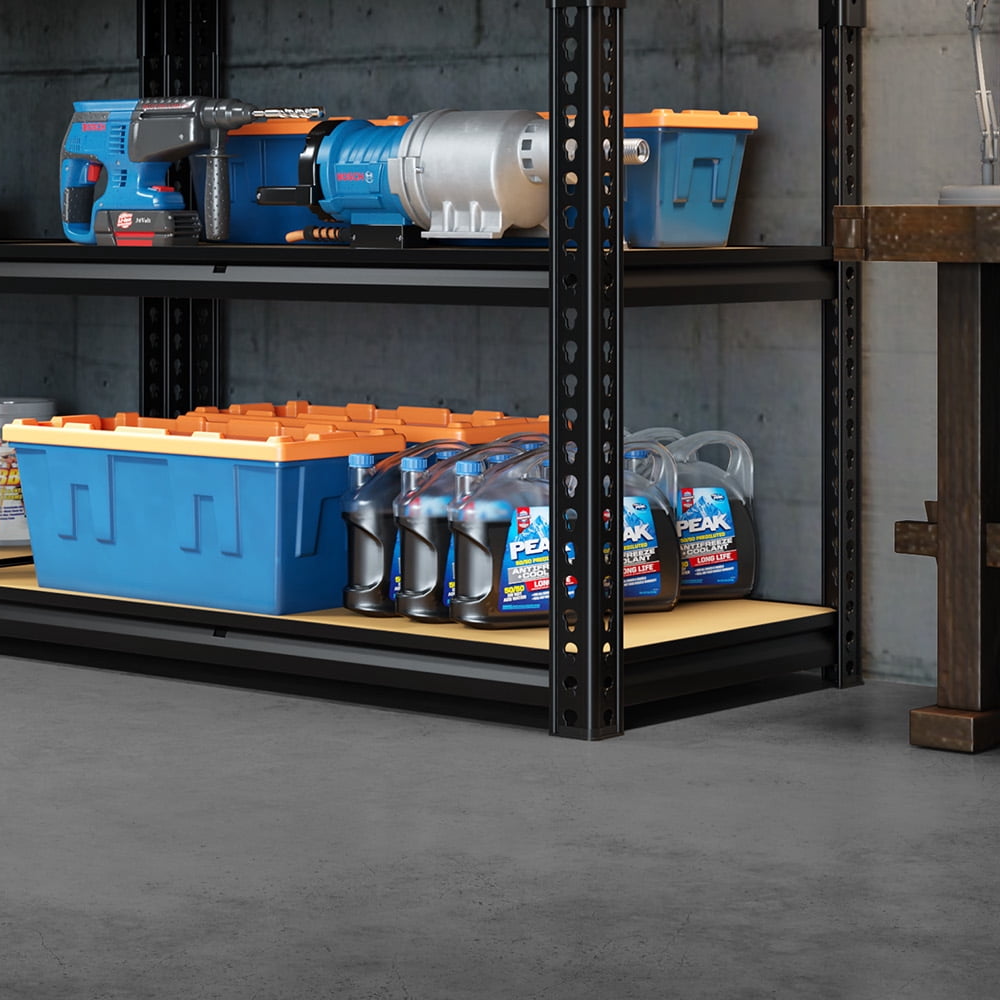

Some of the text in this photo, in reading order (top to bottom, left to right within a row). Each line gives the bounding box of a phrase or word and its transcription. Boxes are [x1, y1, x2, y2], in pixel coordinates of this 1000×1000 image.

[676, 514, 732, 538] PEAK
[509, 537, 550, 561] PEA
[680, 538, 733, 551] ANTIFREEZE
[696, 552, 731, 564] LONG LIFE
[638, 564, 655, 573] LIFE
[534, 579, 550, 588] LON
